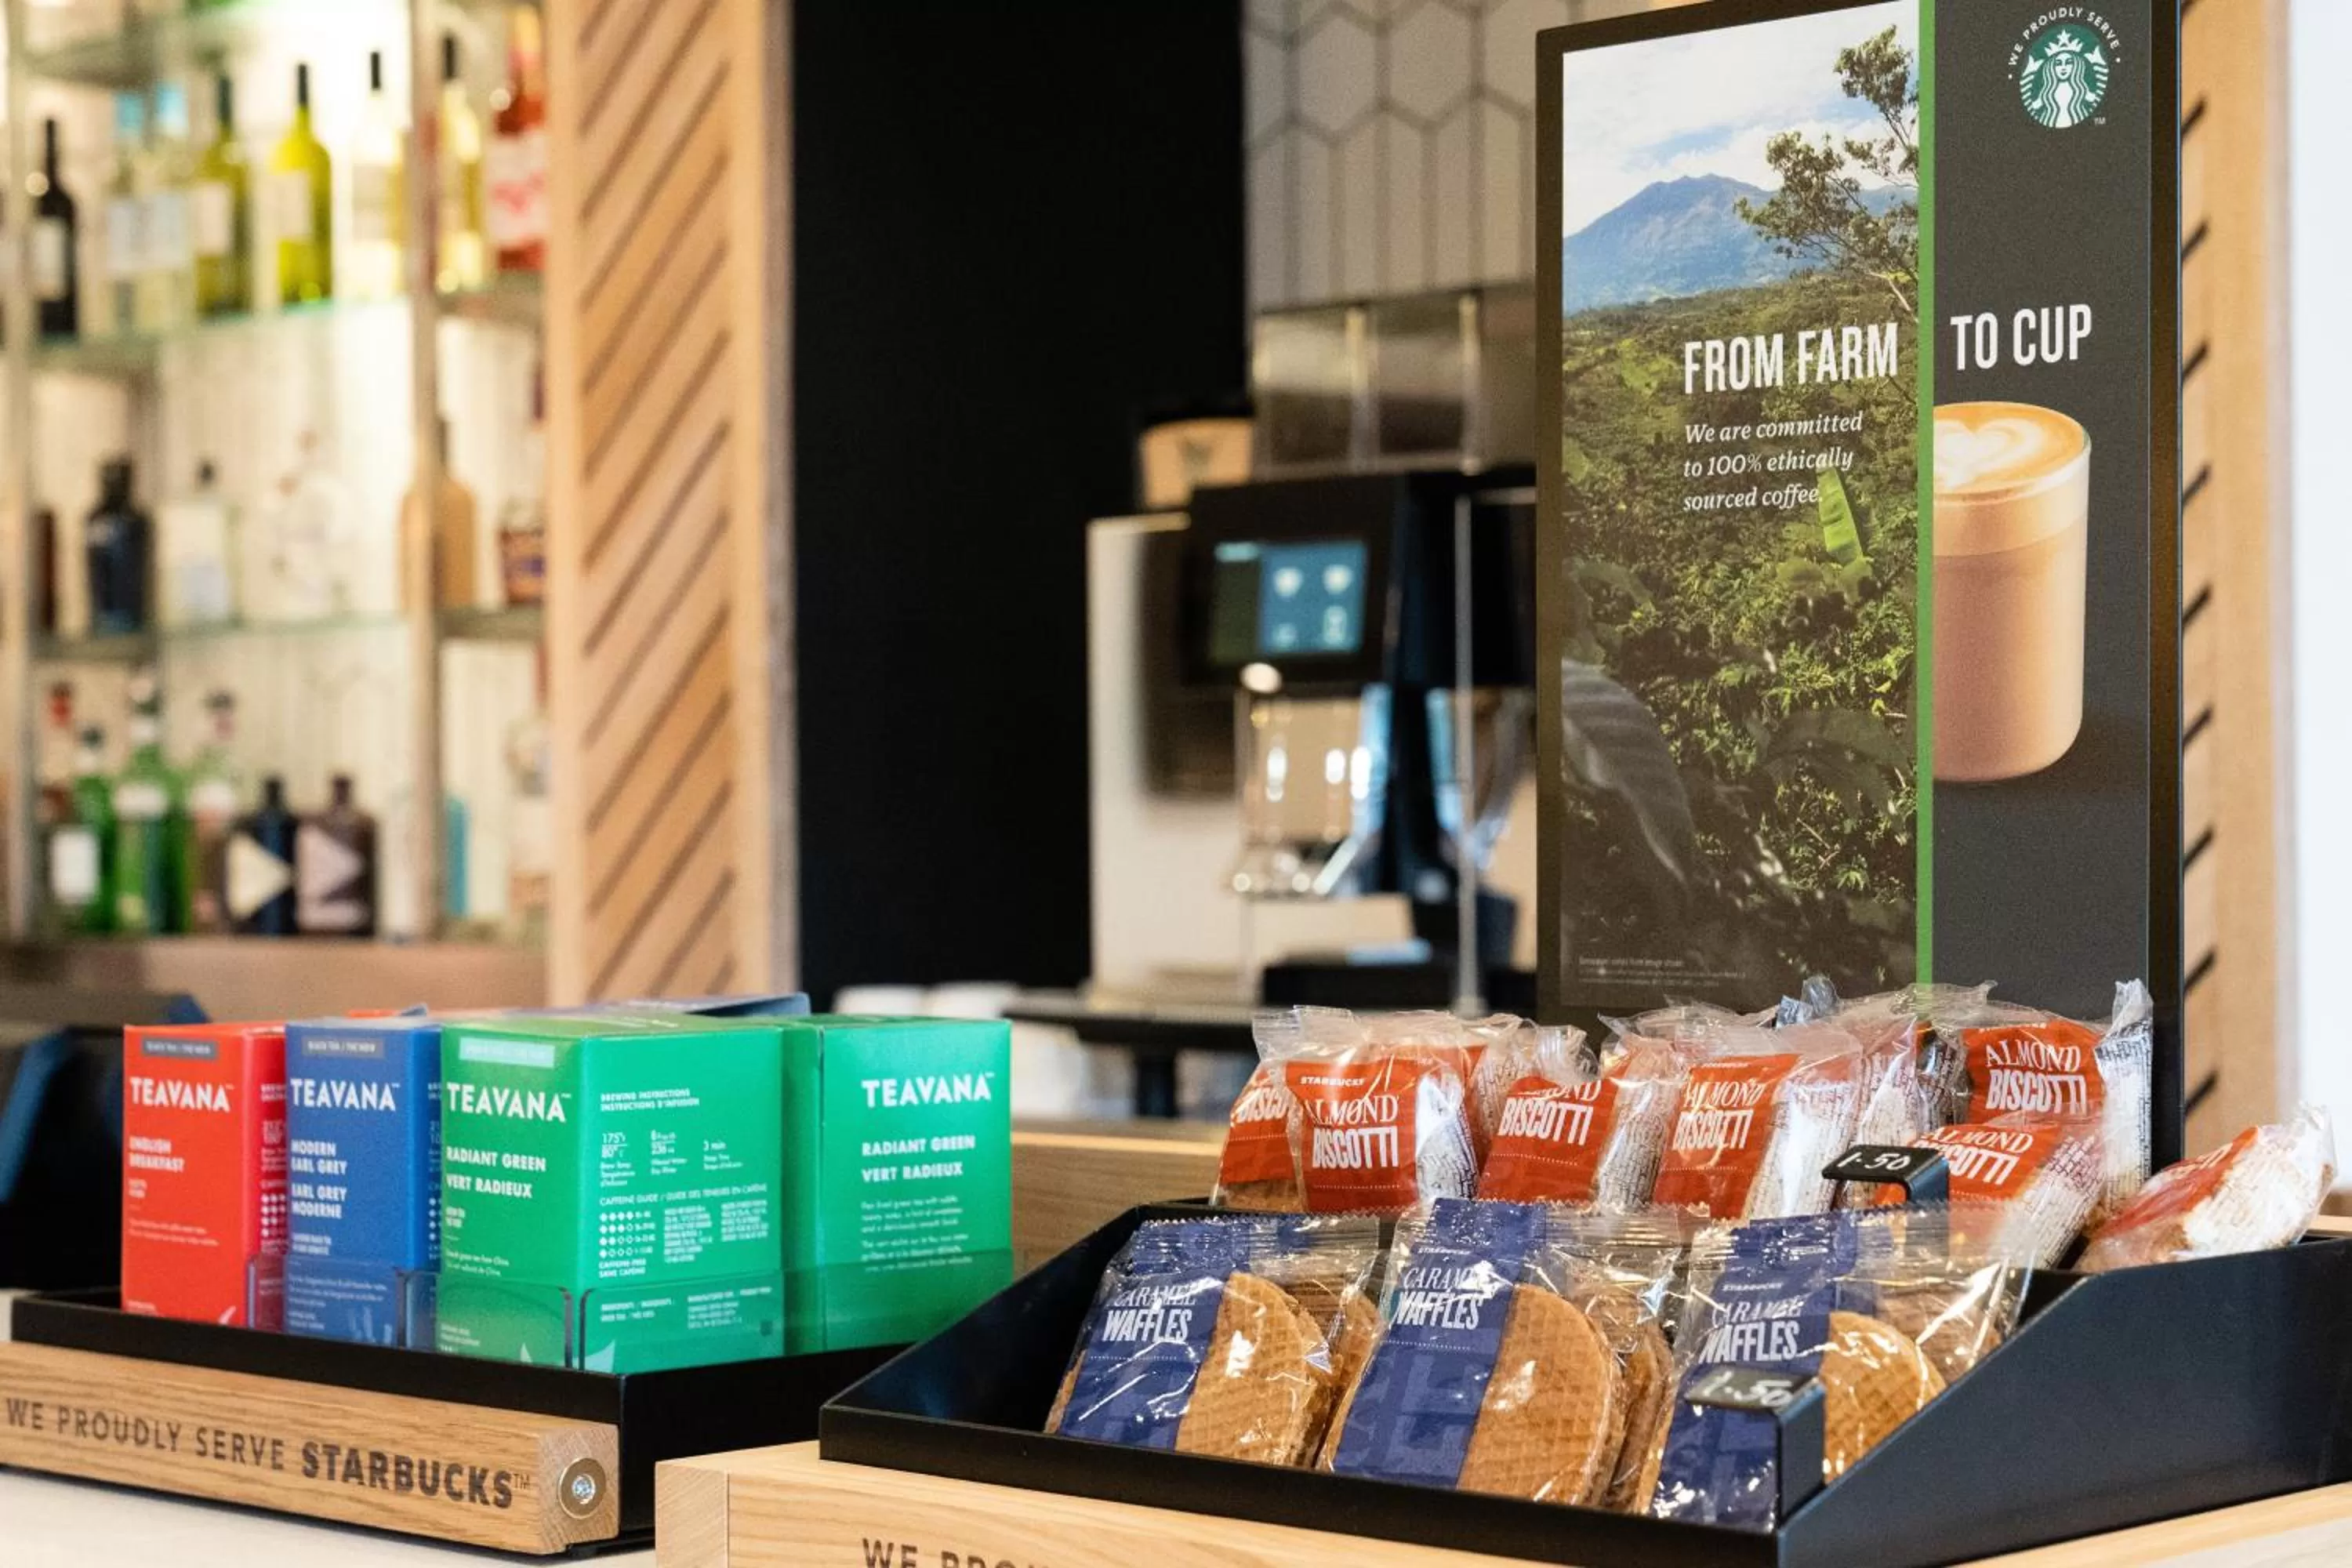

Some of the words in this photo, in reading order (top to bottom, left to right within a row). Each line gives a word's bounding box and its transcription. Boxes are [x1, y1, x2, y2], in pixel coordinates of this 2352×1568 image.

[2008, 42, 2024, 66] WE
[2022, 6, 2084, 40] PROUDLY
[2086, 12, 2120, 50] SERVE
[1685, 334, 1784, 394] FROM
[1798, 322, 1899, 383] FARM
[1951, 313, 1998, 371] TO
[2013, 304, 2092, 366] CUP
[1686, 423, 1716, 444] We
[1719, 425, 1751, 442] are
[1756, 412, 1864, 438] committed
[1684, 460, 1702, 477] to
[1706, 456, 1762, 475] 100%
[1767, 447, 1854, 473] ethically
[1684, 488, 1758, 511] sourced
[1761, 484, 1824, 509] coffee.
[1985, 1039, 2082, 1073] ALMOND
[130, 1076, 230, 1112] TEAVANA
[290, 1078, 396, 1112] TEAVANA
[861, 1073, 992, 1109] TEAVANA
[1300, 1076, 1366, 1087] STARBUCKS
[1985, 1069, 2087, 1116] BISCOTTI
[446, 1082, 567, 1123] TEAVANA
[1236, 1088, 1290, 1124] BISCO
[1497, 1097, 1594, 1145] BISCOTTI
[1671, 1109, 1755, 1150] BISCOTTI
[291, 1139, 336, 1157] MODERN
[446, 1146, 498, 1168] RADIANT
[502, 1152, 546, 1172] GREEN
[862, 1138, 926, 1156] RADIANT
[931, 1135, 976, 1152] GREEN
[1312, 1125, 1399, 1169] BISCOTTI
[317, 1160, 347, 1175] GREY
[862, 1167, 898, 1182] VERT
[902, 1162, 964, 1179] RADIEUX
[317, 1185, 347, 1202] GREY
[446, 1174, 471, 1192] VERT
[474, 1178, 533, 1200] RADIEUX
[1402, 1267, 1483, 1290] CARAM
[1102, 1308, 1192, 1343] WAFFLES
[1396, 1291, 1484, 1330] WAFFLES
[1698, 1319, 1800, 1364] WAFFLES
[6, 1397, 45, 1431] WE
[57, 1405, 180, 1453] PROUDLY
[195, 1428, 285, 1471] SERVE
[301, 1441, 514, 1510] STARBUCKS
